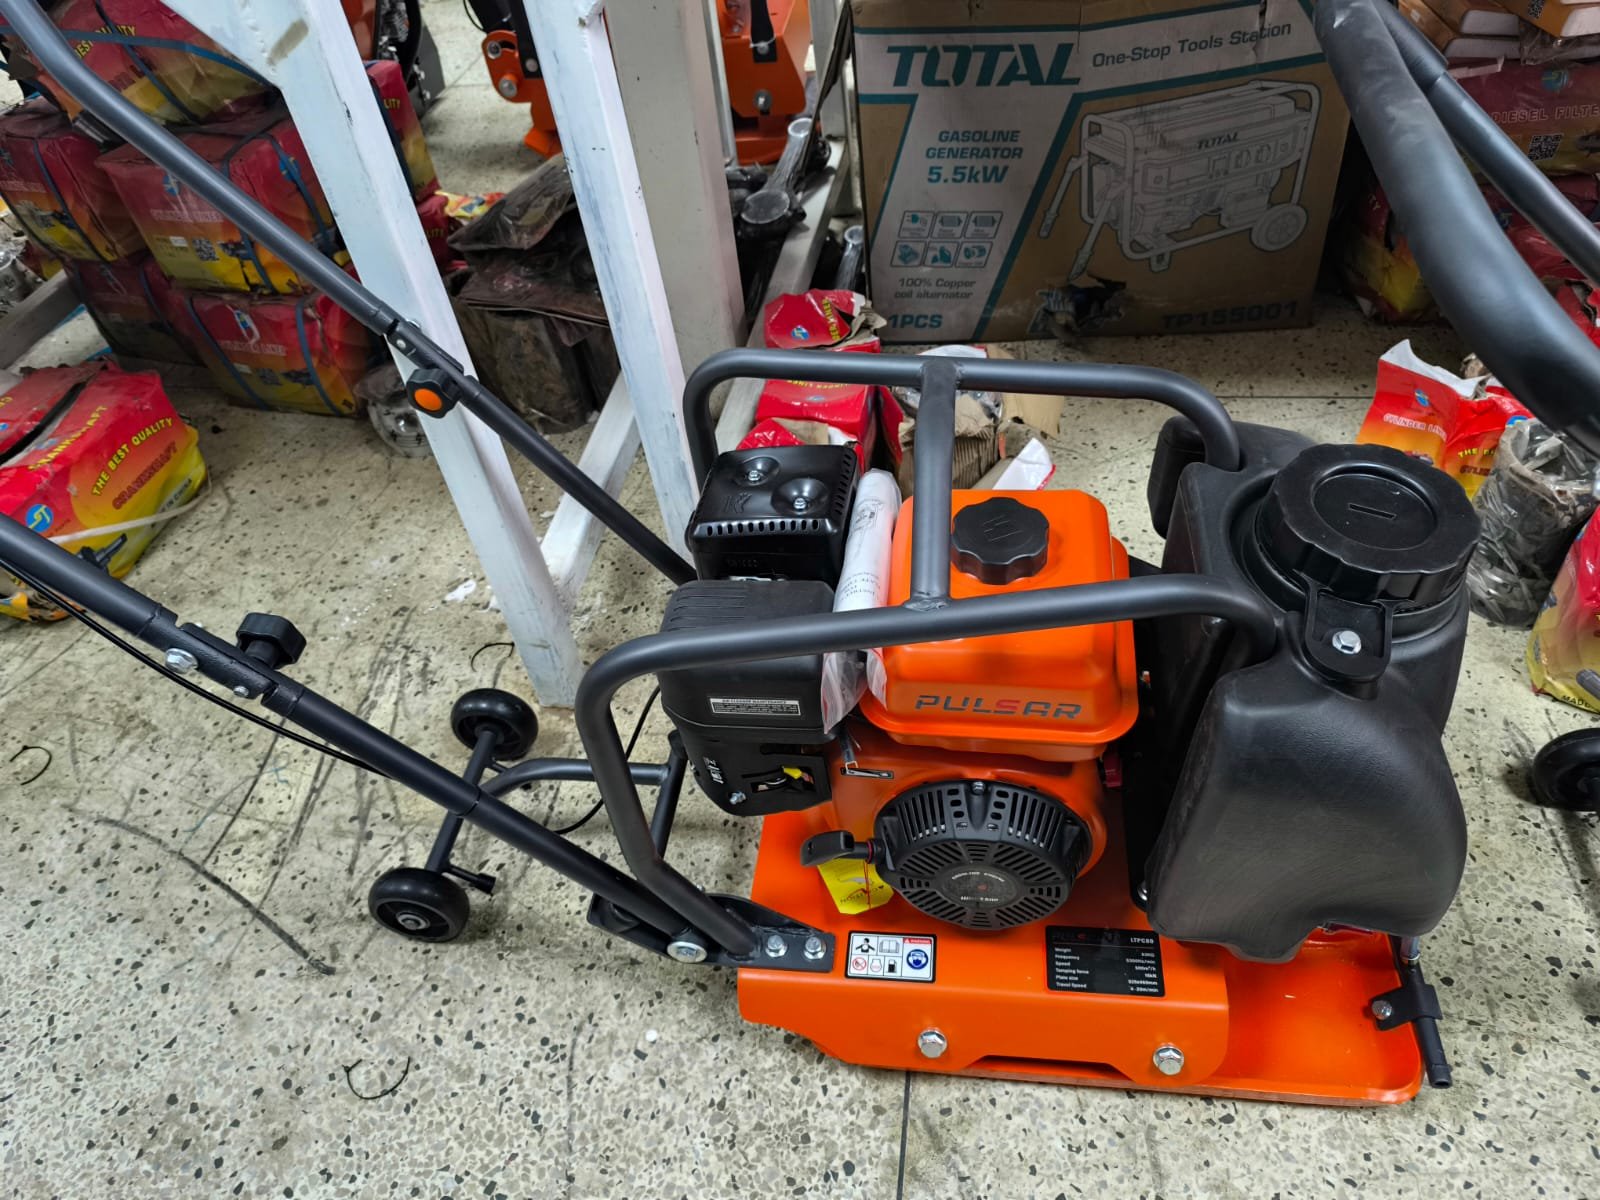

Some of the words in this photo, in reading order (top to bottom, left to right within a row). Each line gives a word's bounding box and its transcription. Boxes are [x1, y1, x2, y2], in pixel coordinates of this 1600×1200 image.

[1092, 44, 1171, 68] One-Stop
[1178, 35, 1223, 53] Tools
[1229, 23, 1292, 46] Station
[886, 43, 1081, 87] TOTAL
[1491, 108, 1549, 124] DIESEL
[938, 130, 1021, 143] GASOLINE
[1197, 131, 1239, 149] TOTAL
[925, 147, 1023, 160] GENERATOR
[927, 165, 1010, 184] 5.5kW
[898, 278, 933, 288] 100%
[935, 278, 976, 289] Copper
[916, 290, 974, 299] alternator
[888, 314, 943, 329] 1PCS
[91, 471, 110, 496] THE
[107, 444, 130, 471] BEST
[131, 417, 173, 446] QUALITY
[1458, 448, 1479, 459] THE
[914, 694, 1083, 720] PULSAR
